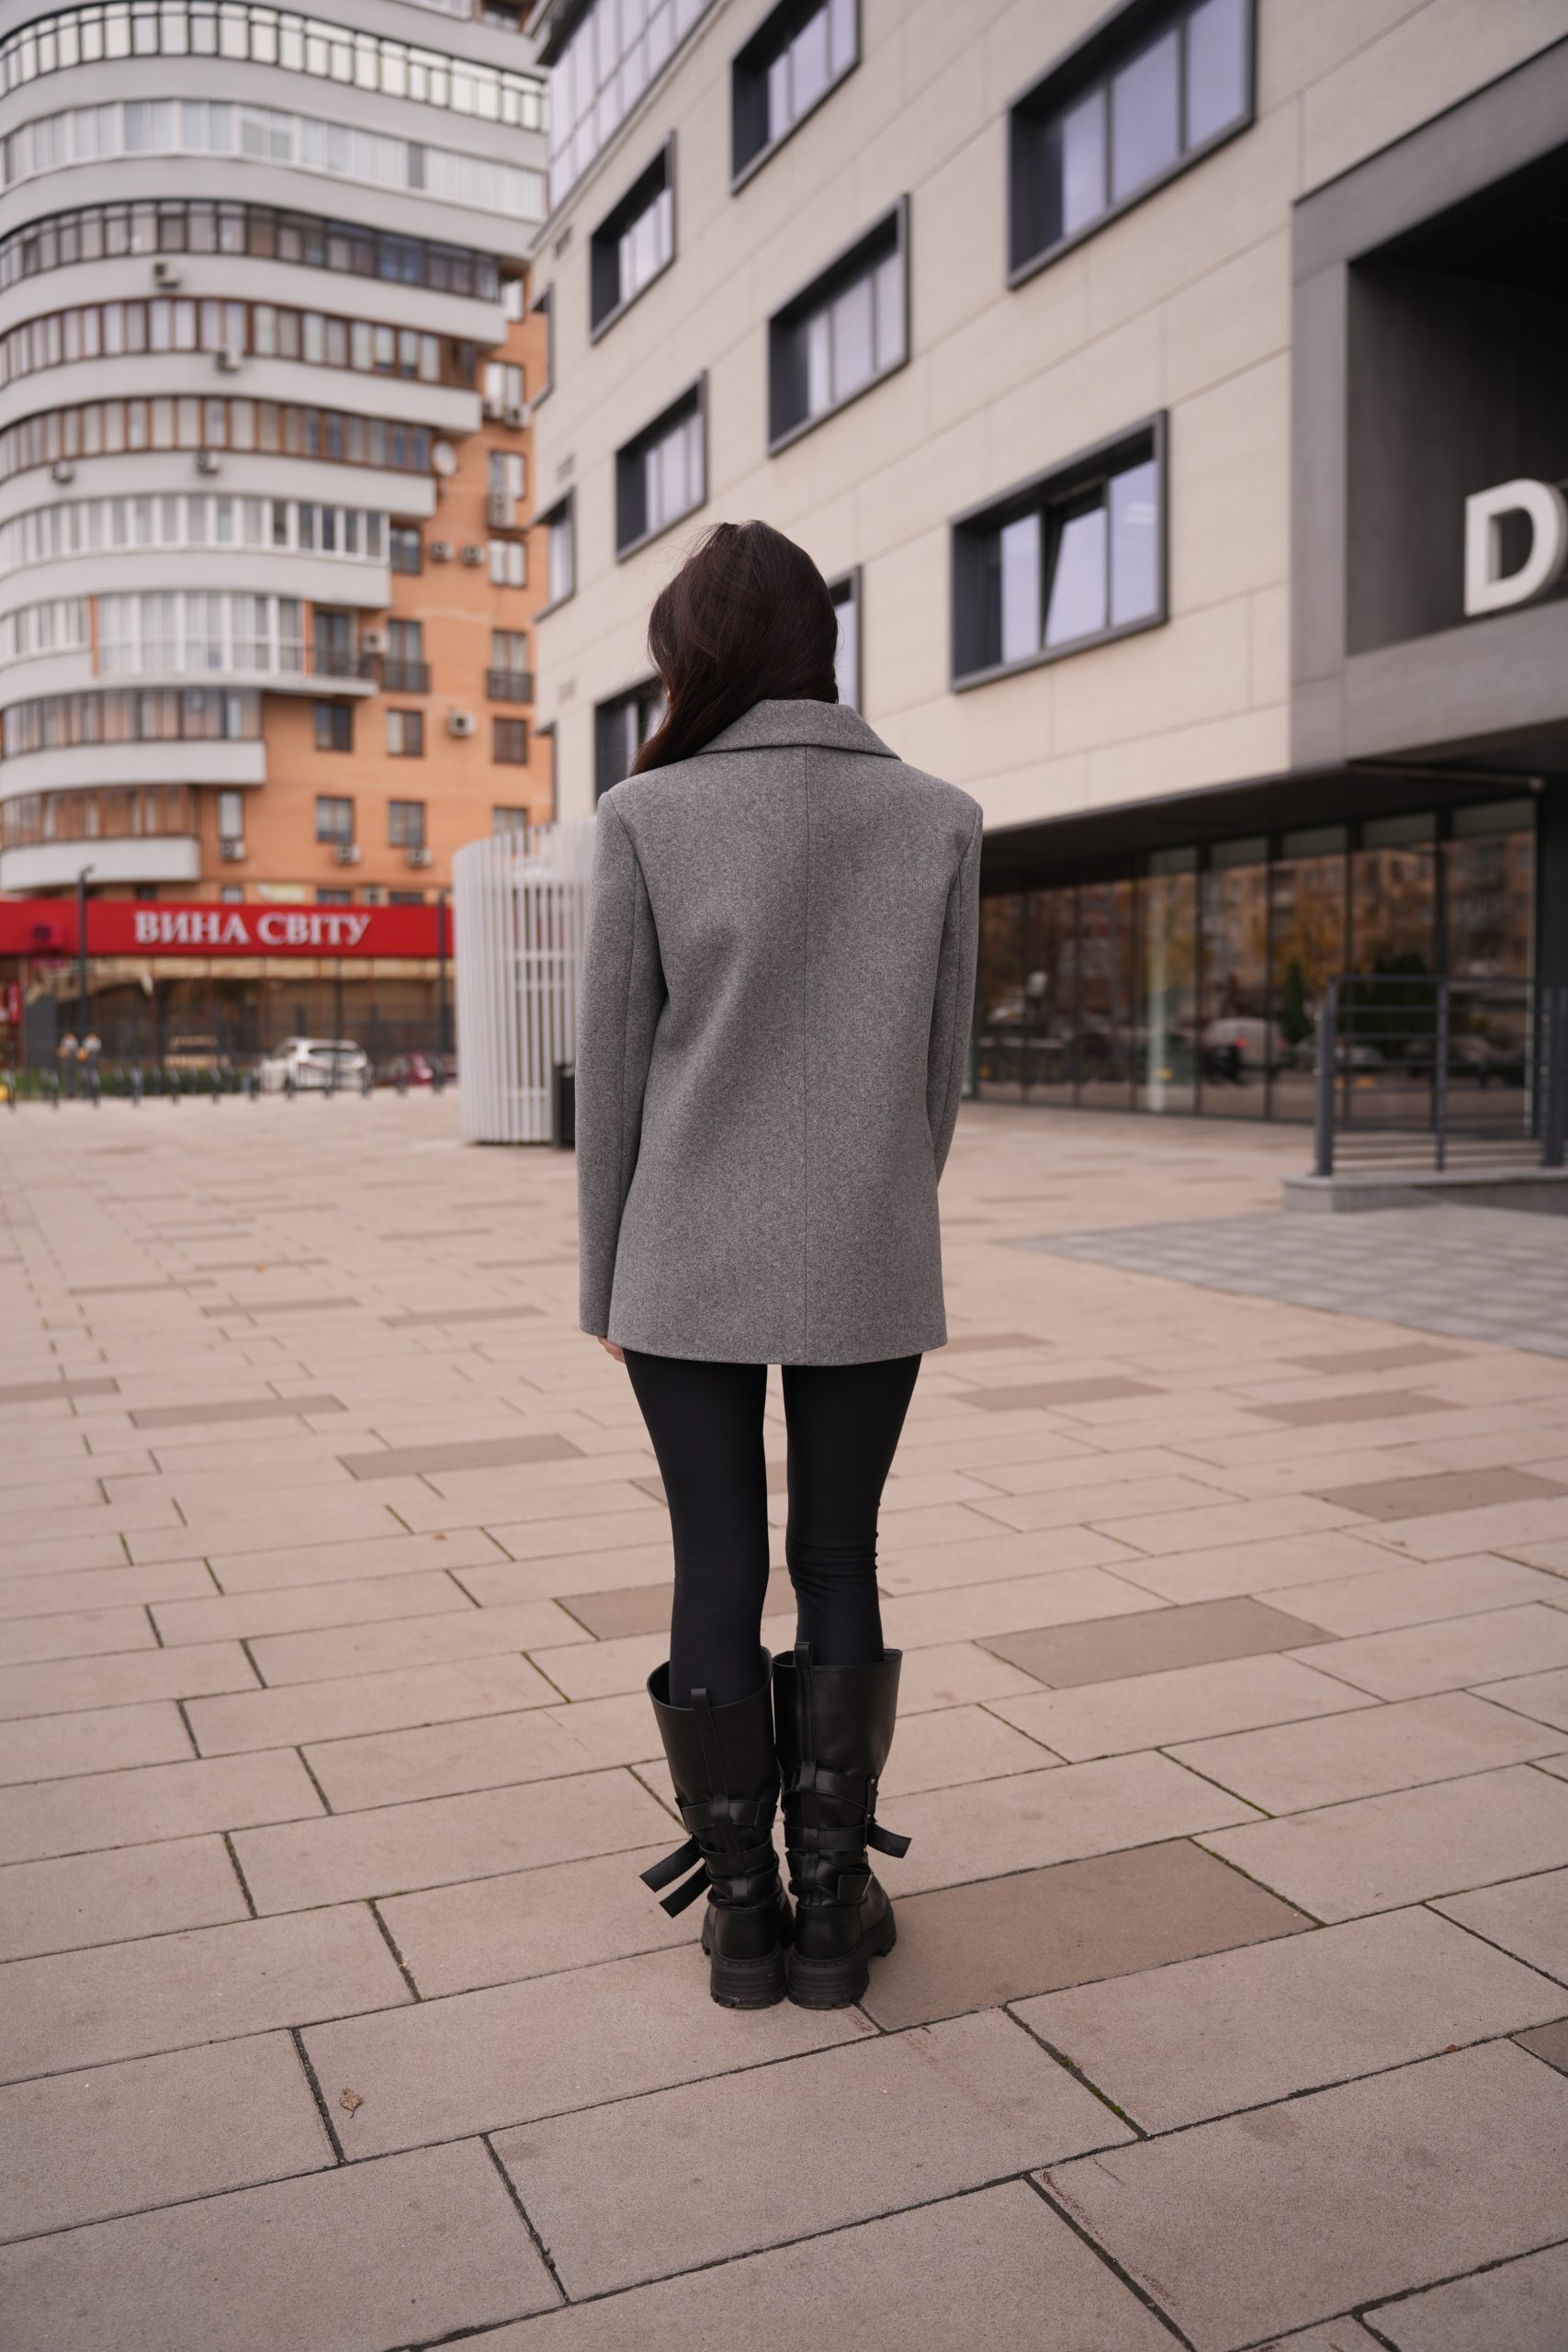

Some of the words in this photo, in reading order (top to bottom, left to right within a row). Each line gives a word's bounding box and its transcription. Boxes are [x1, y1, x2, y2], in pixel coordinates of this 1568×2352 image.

[1464, 478, 1567, 616] D
[134, 910, 249, 944] ВИНА
[257, 912, 370, 946] СВІТУ
